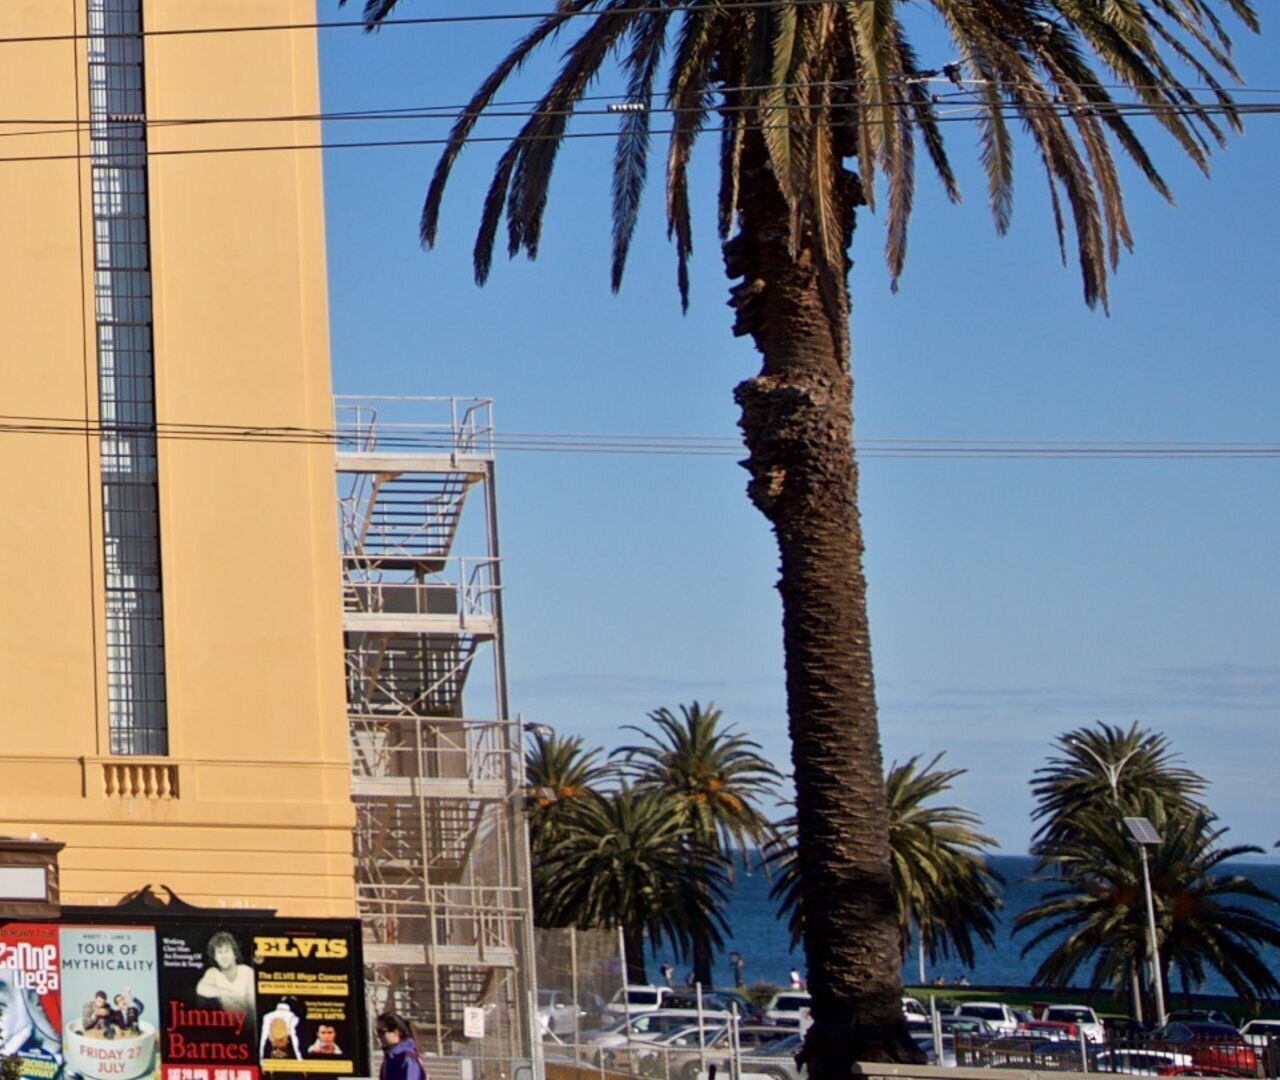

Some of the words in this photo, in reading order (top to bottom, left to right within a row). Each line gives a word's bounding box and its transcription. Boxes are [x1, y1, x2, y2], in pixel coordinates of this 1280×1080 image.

[77, 943, 114, 955] TOUR
[120, 944, 138, 955] OF
[253, 936, 348, 958] ELVIS
[62, 959, 154, 971] MYTHICALITY
[258, 971, 272, 979] The
[273, 972, 295, 980] ELVIS
[318, 972, 348, 981] Concert
[167, 1001, 247, 1035] Jimmy
[80, 1044, 124, 1059] FRIDAY
[128, 1046, 143, 1059] 27
[168, 1033, 249, 1059] Barnes
[98, 1062, 126, 1073] JULY
